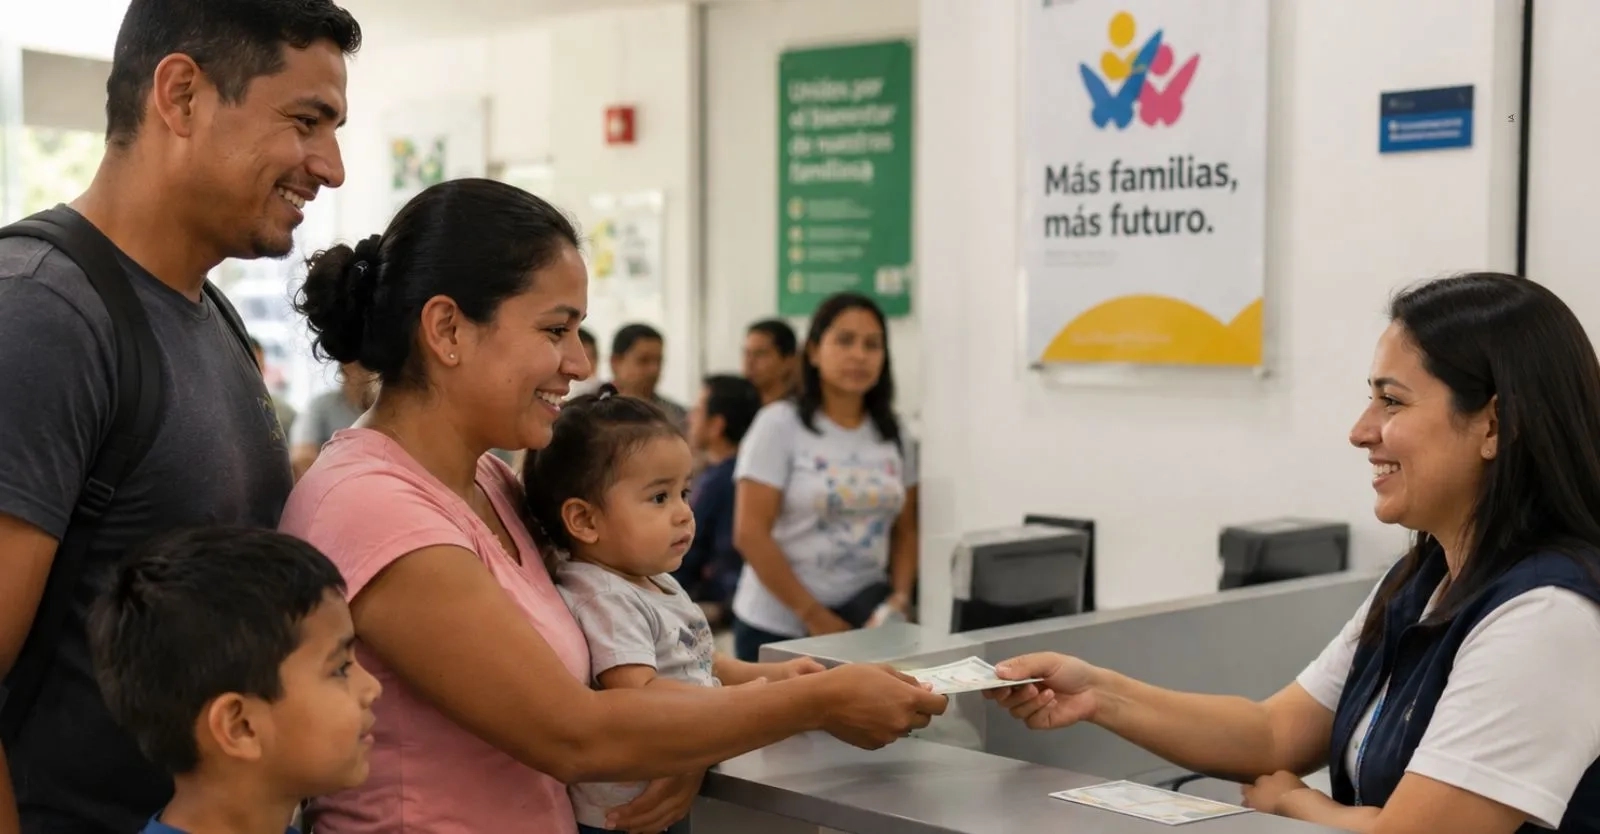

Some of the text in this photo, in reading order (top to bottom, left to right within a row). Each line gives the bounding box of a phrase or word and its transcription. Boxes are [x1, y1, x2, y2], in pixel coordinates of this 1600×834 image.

[1044, 156, 1239, 195] Más familias,
[1044, 203, 1214, 238] más futuro.
